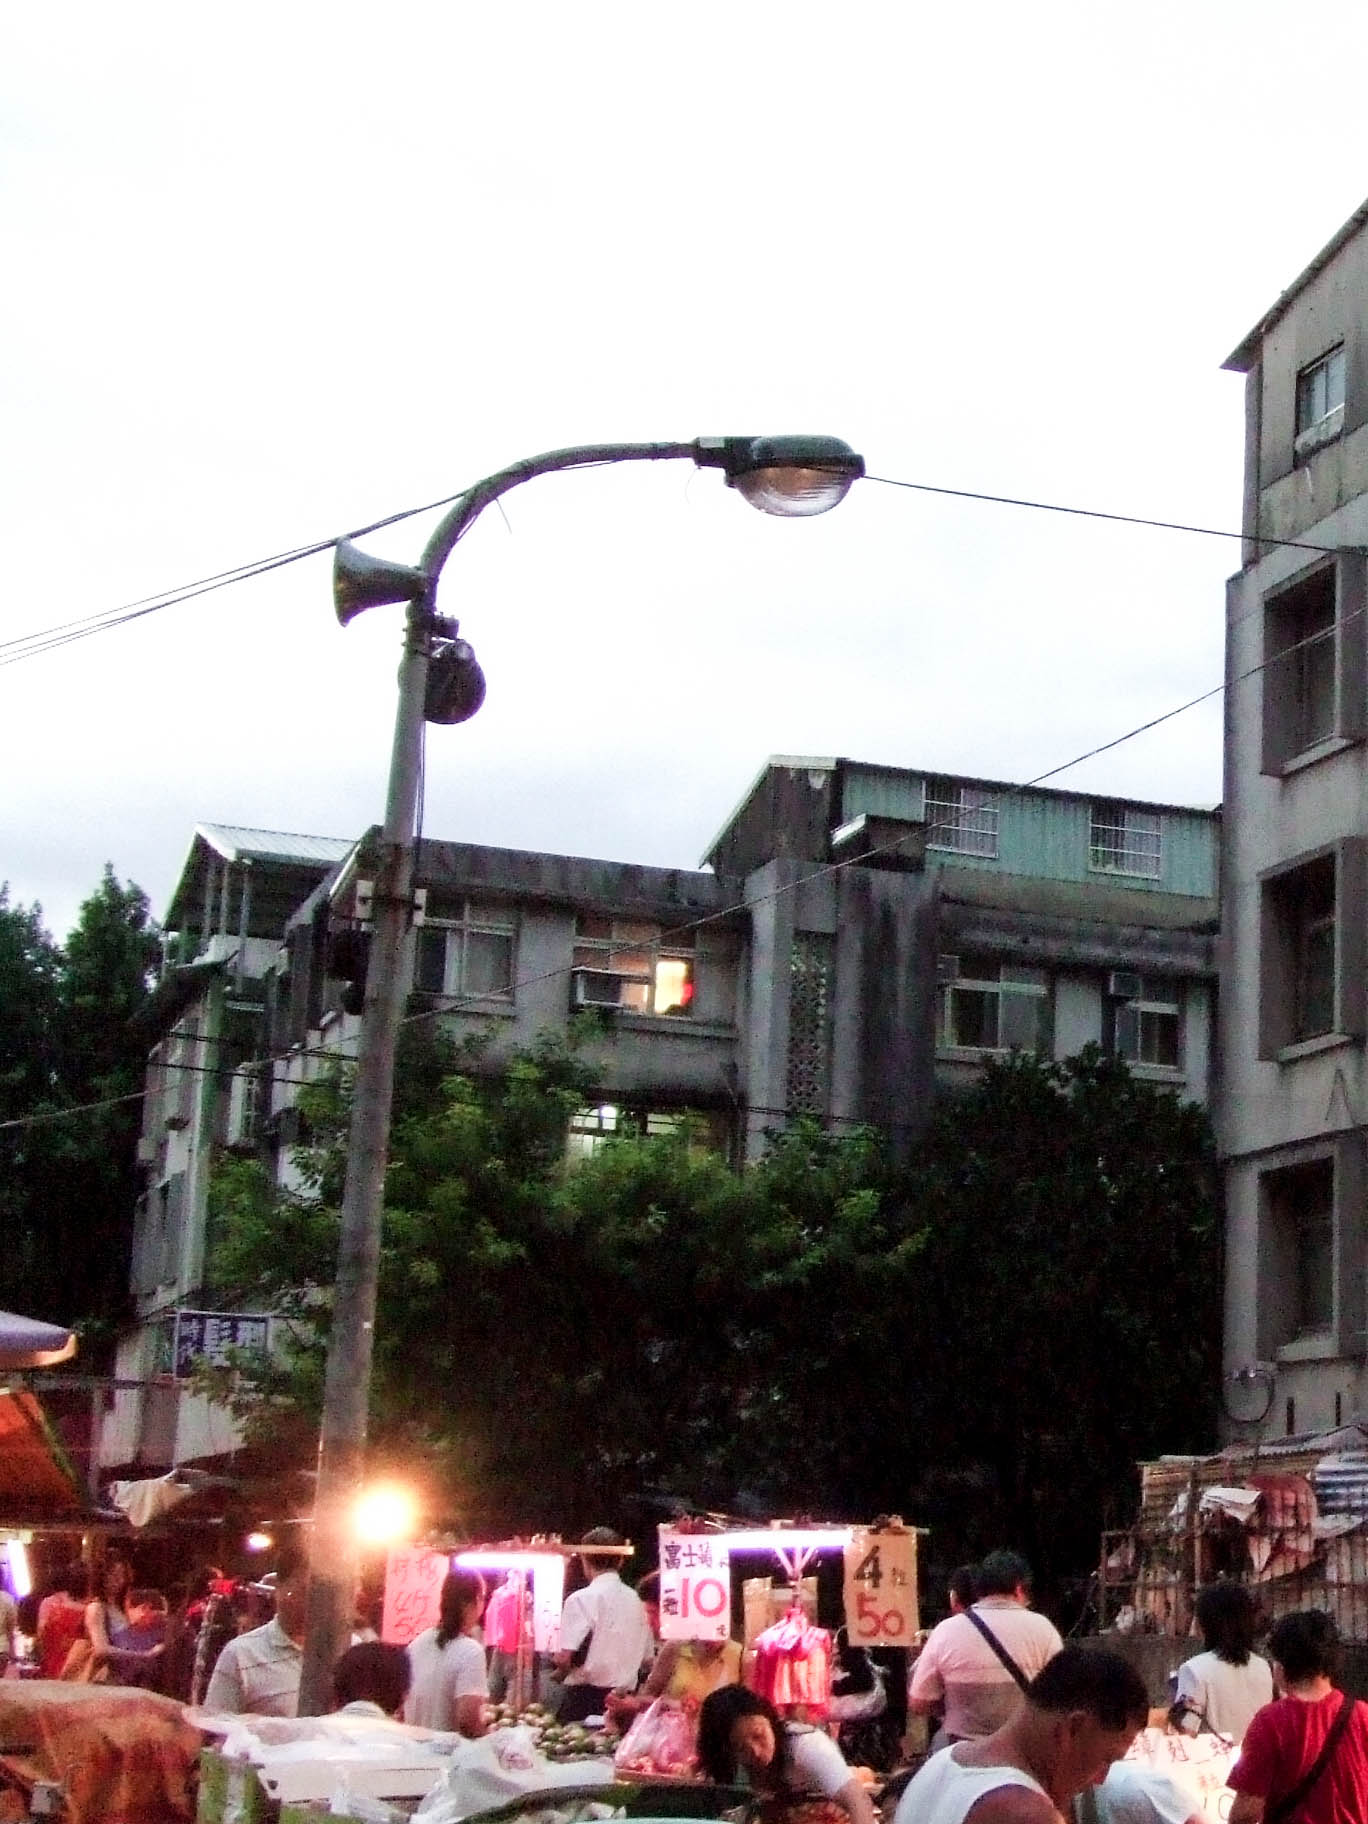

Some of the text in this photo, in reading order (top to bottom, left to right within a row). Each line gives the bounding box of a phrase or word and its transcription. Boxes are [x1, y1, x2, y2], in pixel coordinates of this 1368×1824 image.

[664, 1541, 729, 1569] 富士蘋
[853, 1545, 883, 1588] 4
[681, 1578, 727, 1618] 10
[856, 1592, 905, 1638] 50
